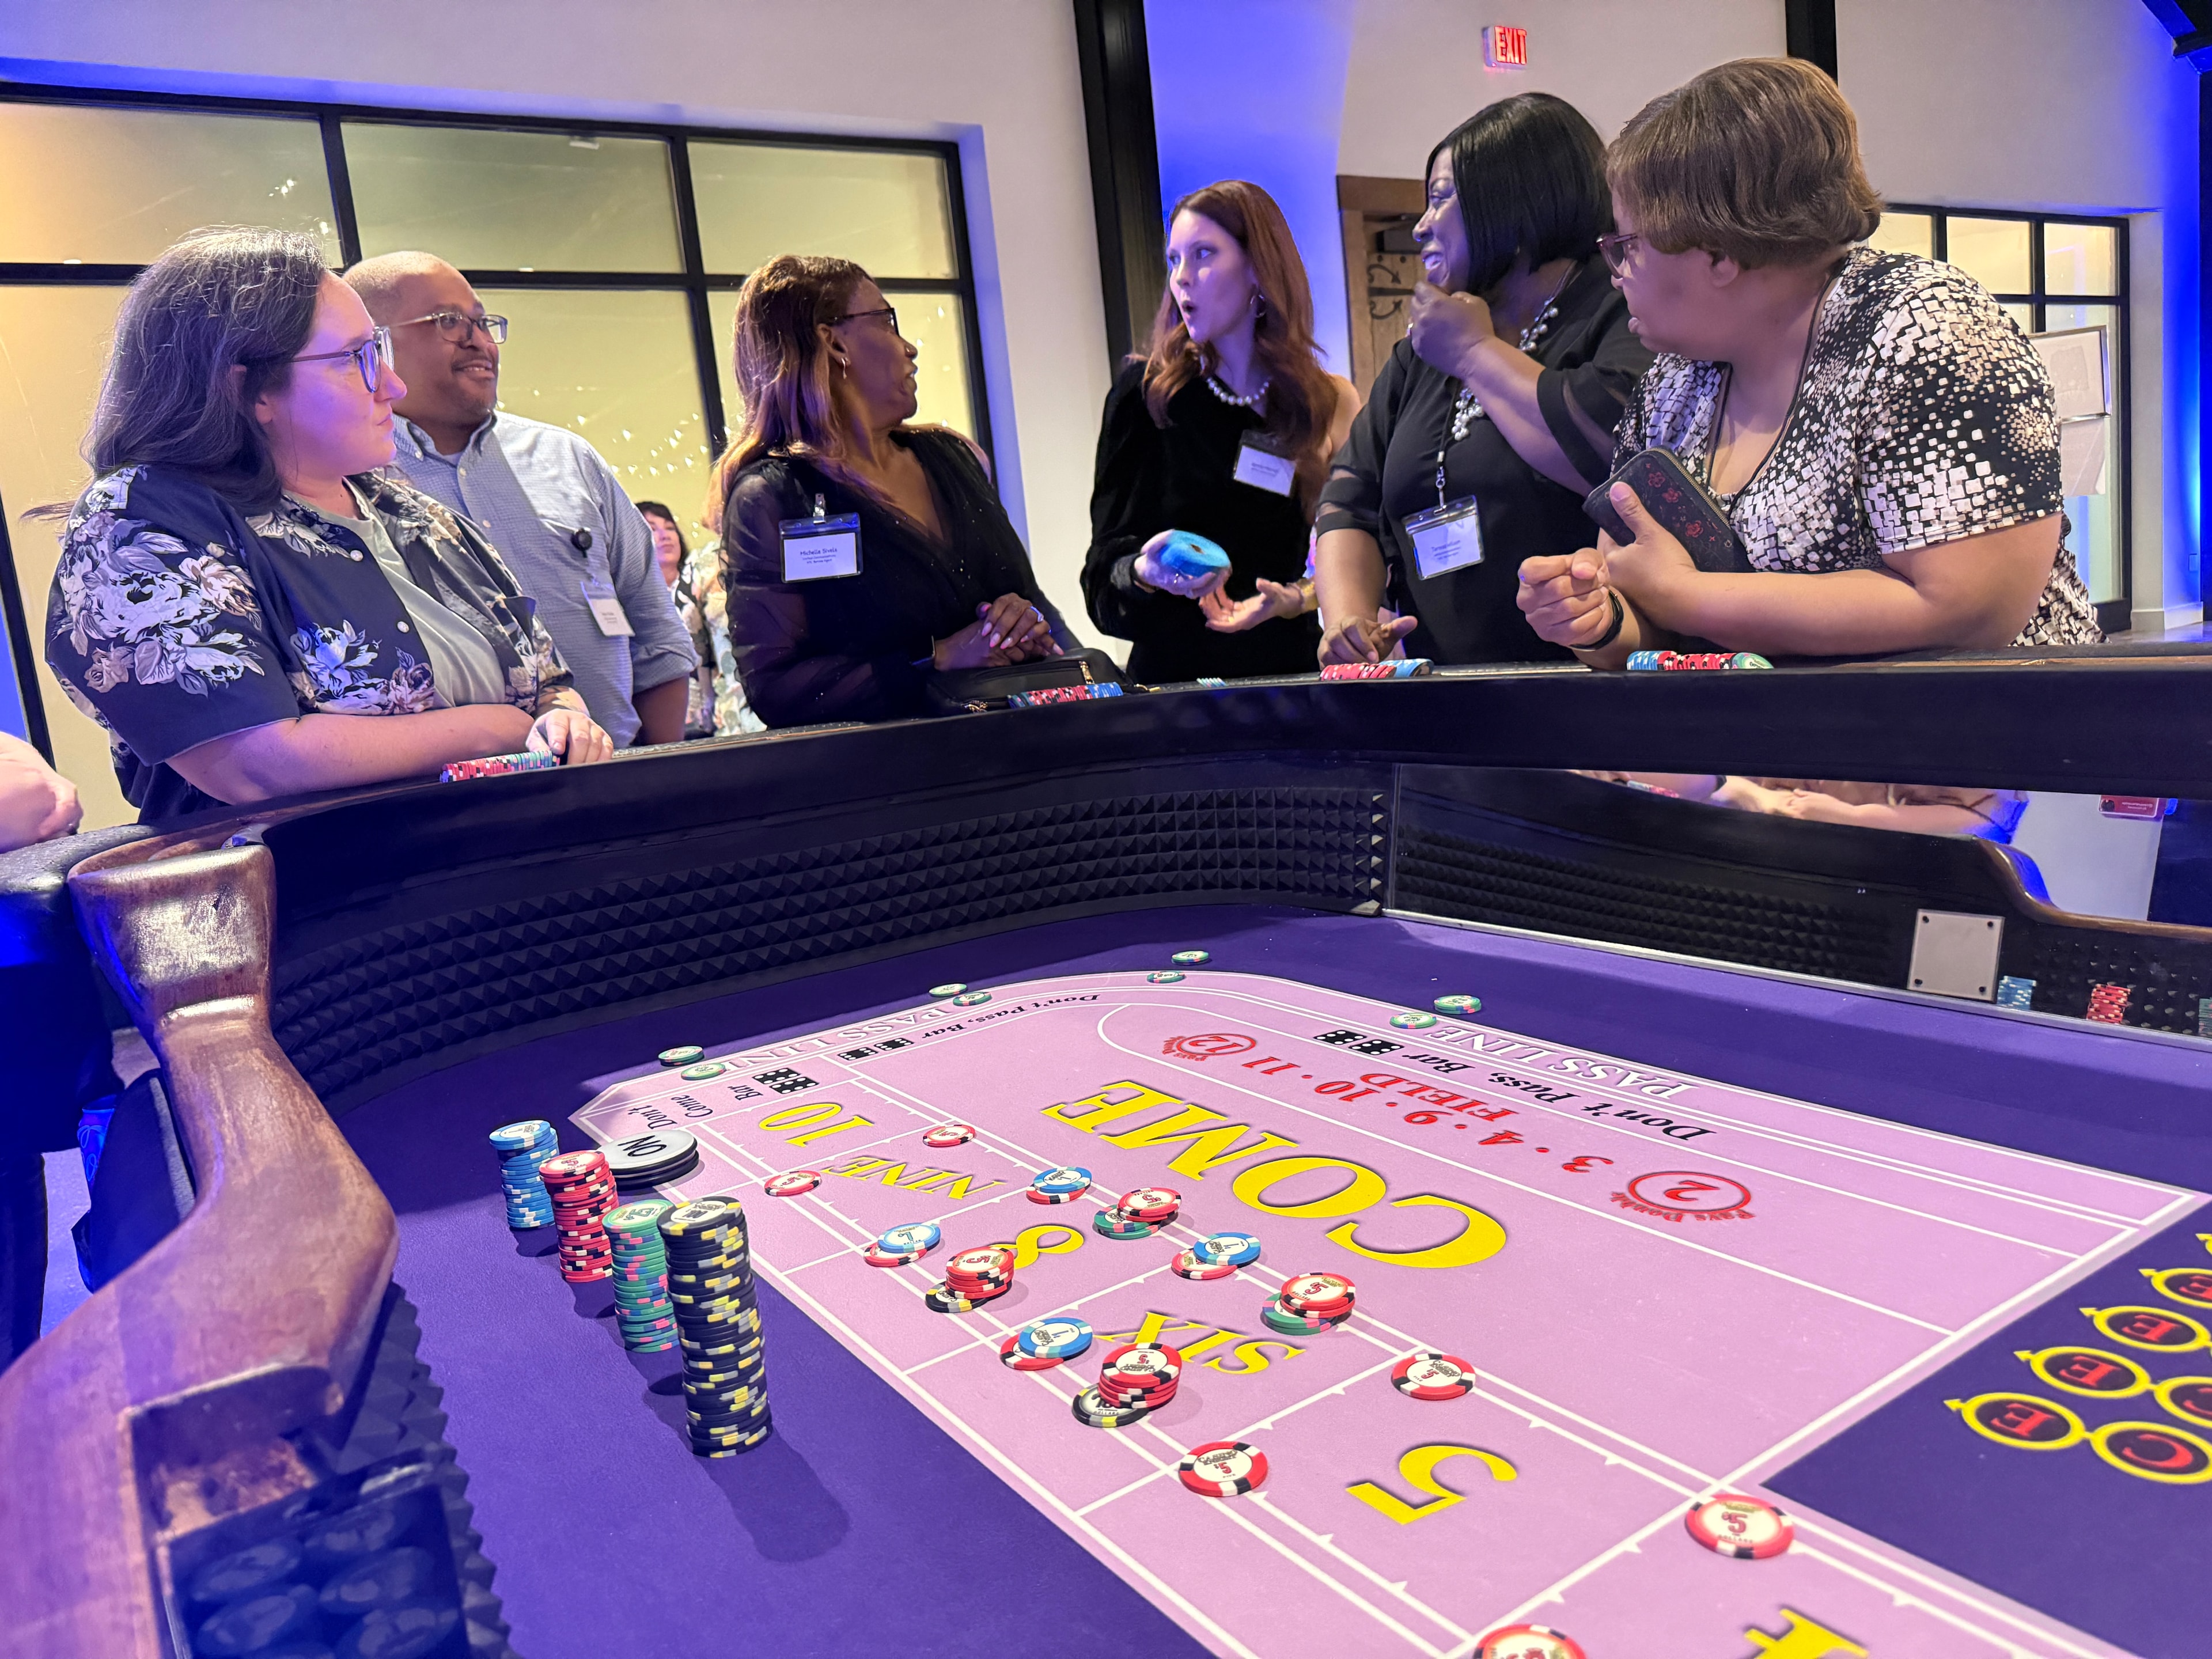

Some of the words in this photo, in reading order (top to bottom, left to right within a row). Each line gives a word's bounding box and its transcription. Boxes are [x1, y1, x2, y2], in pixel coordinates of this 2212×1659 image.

[1494, 26, 1527, 65] EXIT
[1031, 994, 1101, 1008] Don't
[837, 1007, 950, 1041] PASS
[922, 1024, 967, 1039] Bar
[725, 1037, 835, 1073] LIN
[1188, 1036, 1243, 1054] 12
[1425, 1027, 1560, 1065] LINE
[1242, 1056, 1301, 1075] 11
[1401, 1051, 1476, 1074] Bar
[1314, 1080, 1381, 1103] 10
[1488, 1073, 1582, 1103] Pass,
[1548, 1058, 1700, 1099] PASS
[671, 1094, 714, 1118] Come
[728, 1085, 764, 1101] Bar
[1359, 1073, 1520, 1122] FIELD
[628, 1105, 678, 1130] Don't
[758, 1103, 874, 1147] 10
[1404, 1111, 1453, 1126] 9
[1581, 1103, 1717, 1141] Don't
[618, 1135, 667, 1157] ON
[1479, 1129, 1525, 1146] 4
[821, 1156, 1007, 1200] NINE
[1040, 1081, 1507, 1268] COME
[1562, 1156, 1614, 1173] 3
[1665, 1180, 1721, 1202] 2
[2122, 1314, 2182, 1343] E
[1093, 1312, 1306, 1374] SIX
[1137, 1354, 1150, 1365] $5
[2059, 1355, 2123, 1387] E
[1991, 1402, 2057, 1438] E
[2122, 1433, 2193, 1468] C
[1213, 1461, 1233, 1474] $5
[1345, 1445, 1518, 1525] 5
[1721, 1511, 1749, 1534] $5
